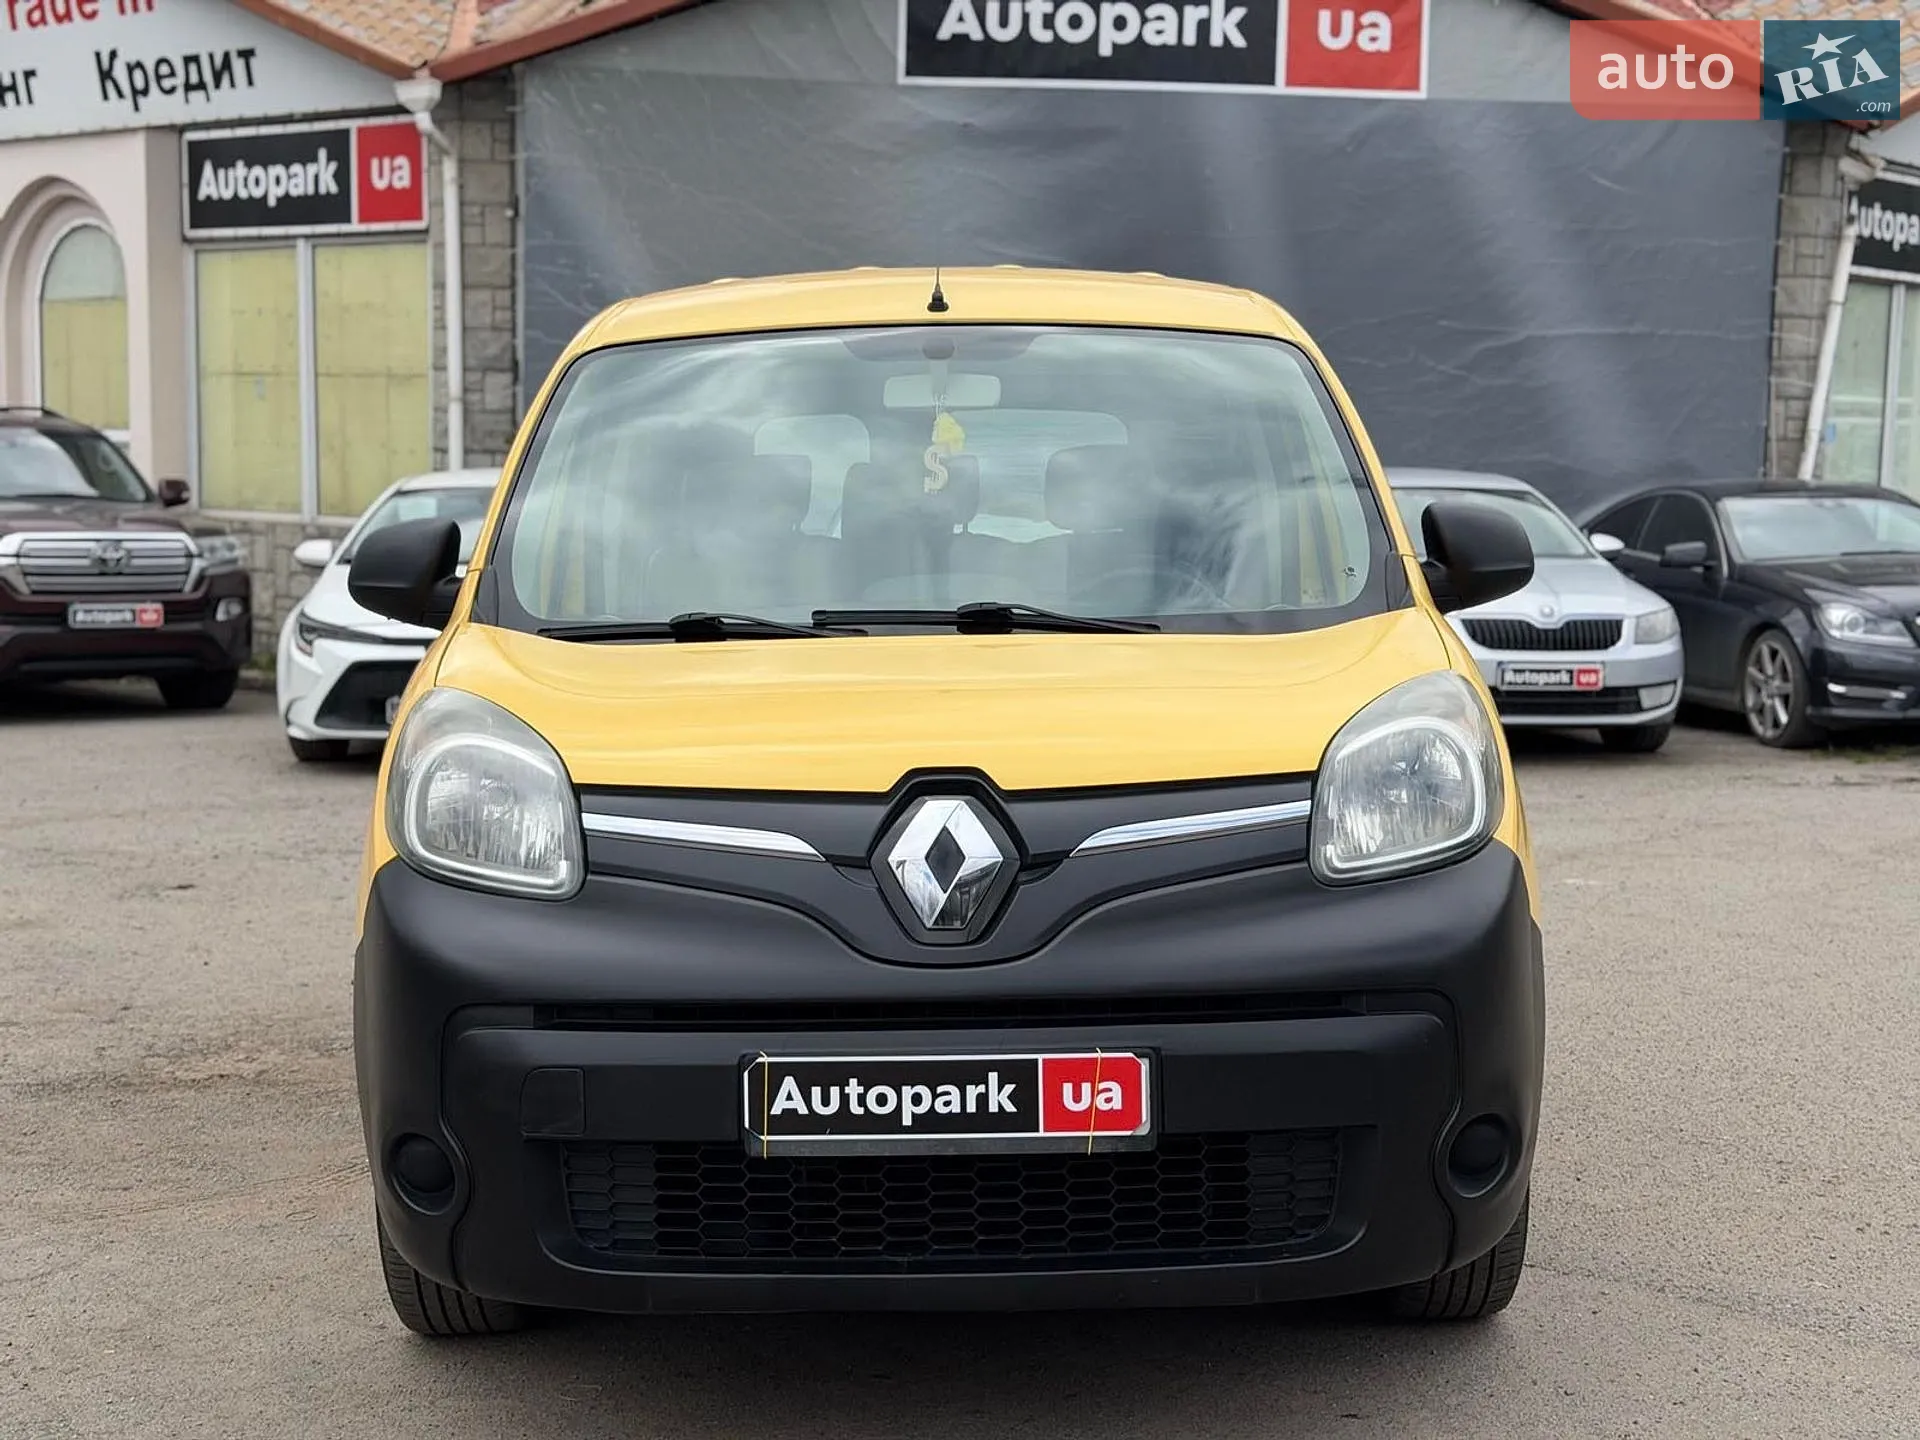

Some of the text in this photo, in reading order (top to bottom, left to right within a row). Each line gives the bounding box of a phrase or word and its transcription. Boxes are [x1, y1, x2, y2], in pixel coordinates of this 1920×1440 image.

[935, 0, 1392, 57] Autopark ua
[94, 48, 257, 112] Кредит
[197, 147, 412, 208] Autopark ua
[1503, 670, 1571, 686] Autopark
[770, 1071, 1123, 1126] Autopark ua
